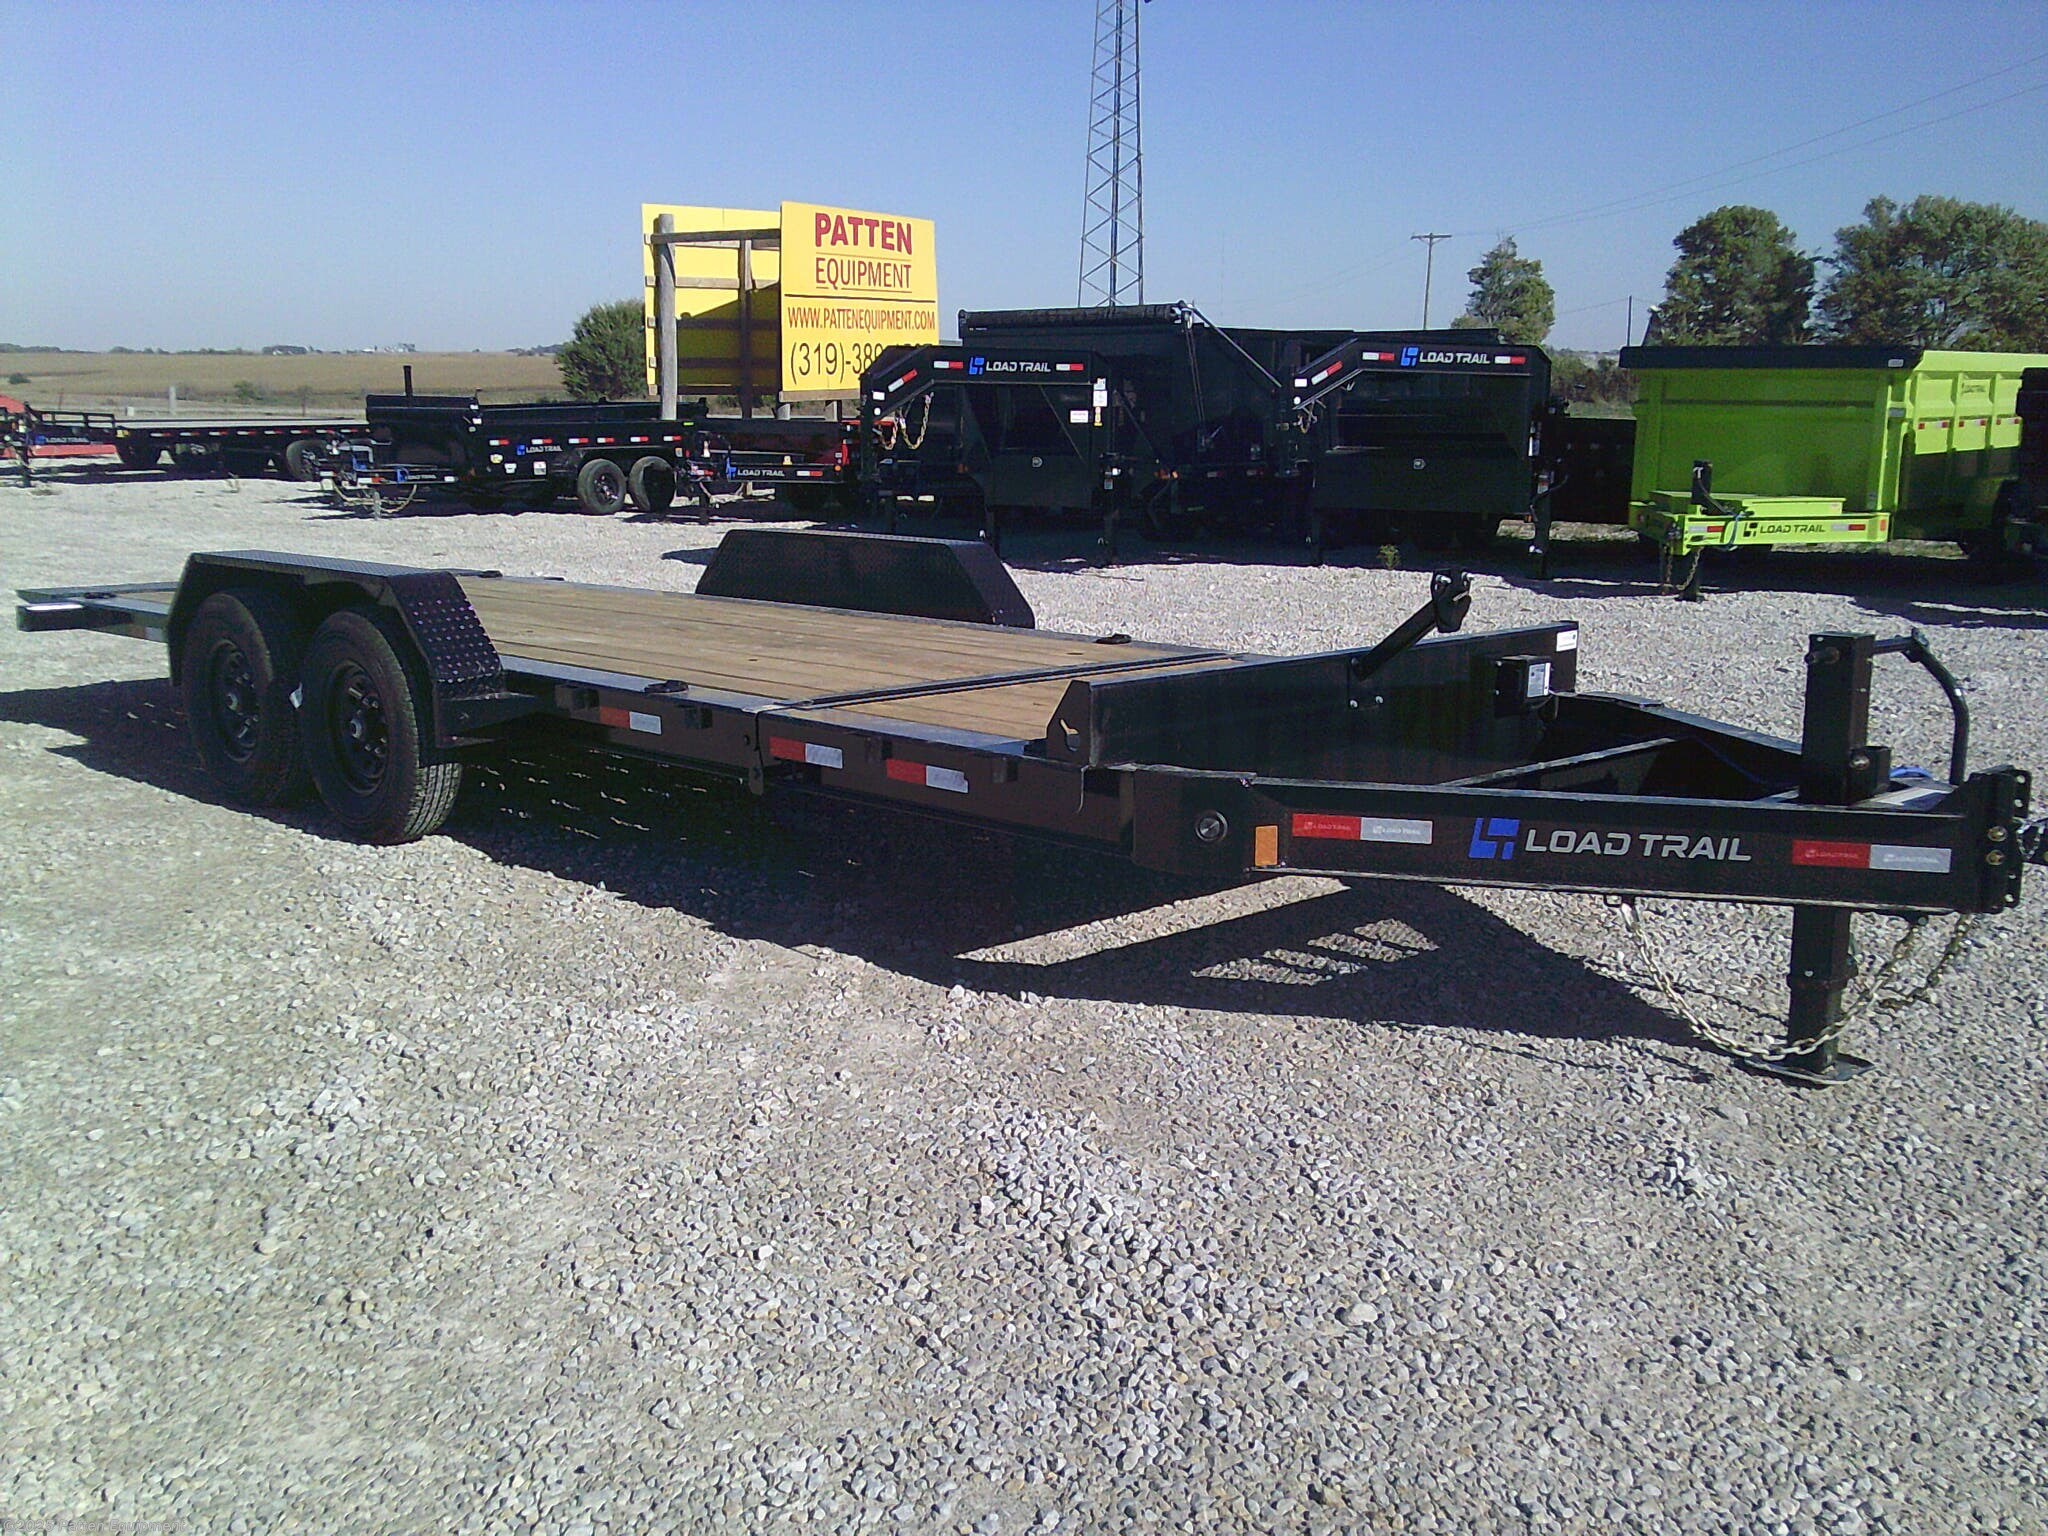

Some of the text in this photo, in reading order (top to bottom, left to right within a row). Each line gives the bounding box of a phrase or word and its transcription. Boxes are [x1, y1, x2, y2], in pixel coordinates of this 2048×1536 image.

[815, 213, 912, 255] PATTEN
[815, 257, 912, 290] EQUIPMENT
[788, 307, 935, 333] WWW.PATTENEQUIPMENT.COM
[986, 361, 1051, 372] LOAD TRAIL
[1419, 352, 1490, 364] LOAD TRAIL
[762, 469, 785, 477] TRAIL
[1760, 524, 1825, 534] LOAD TRAIL
[1525, 829, 1752, 861] LOAD TRAIL
